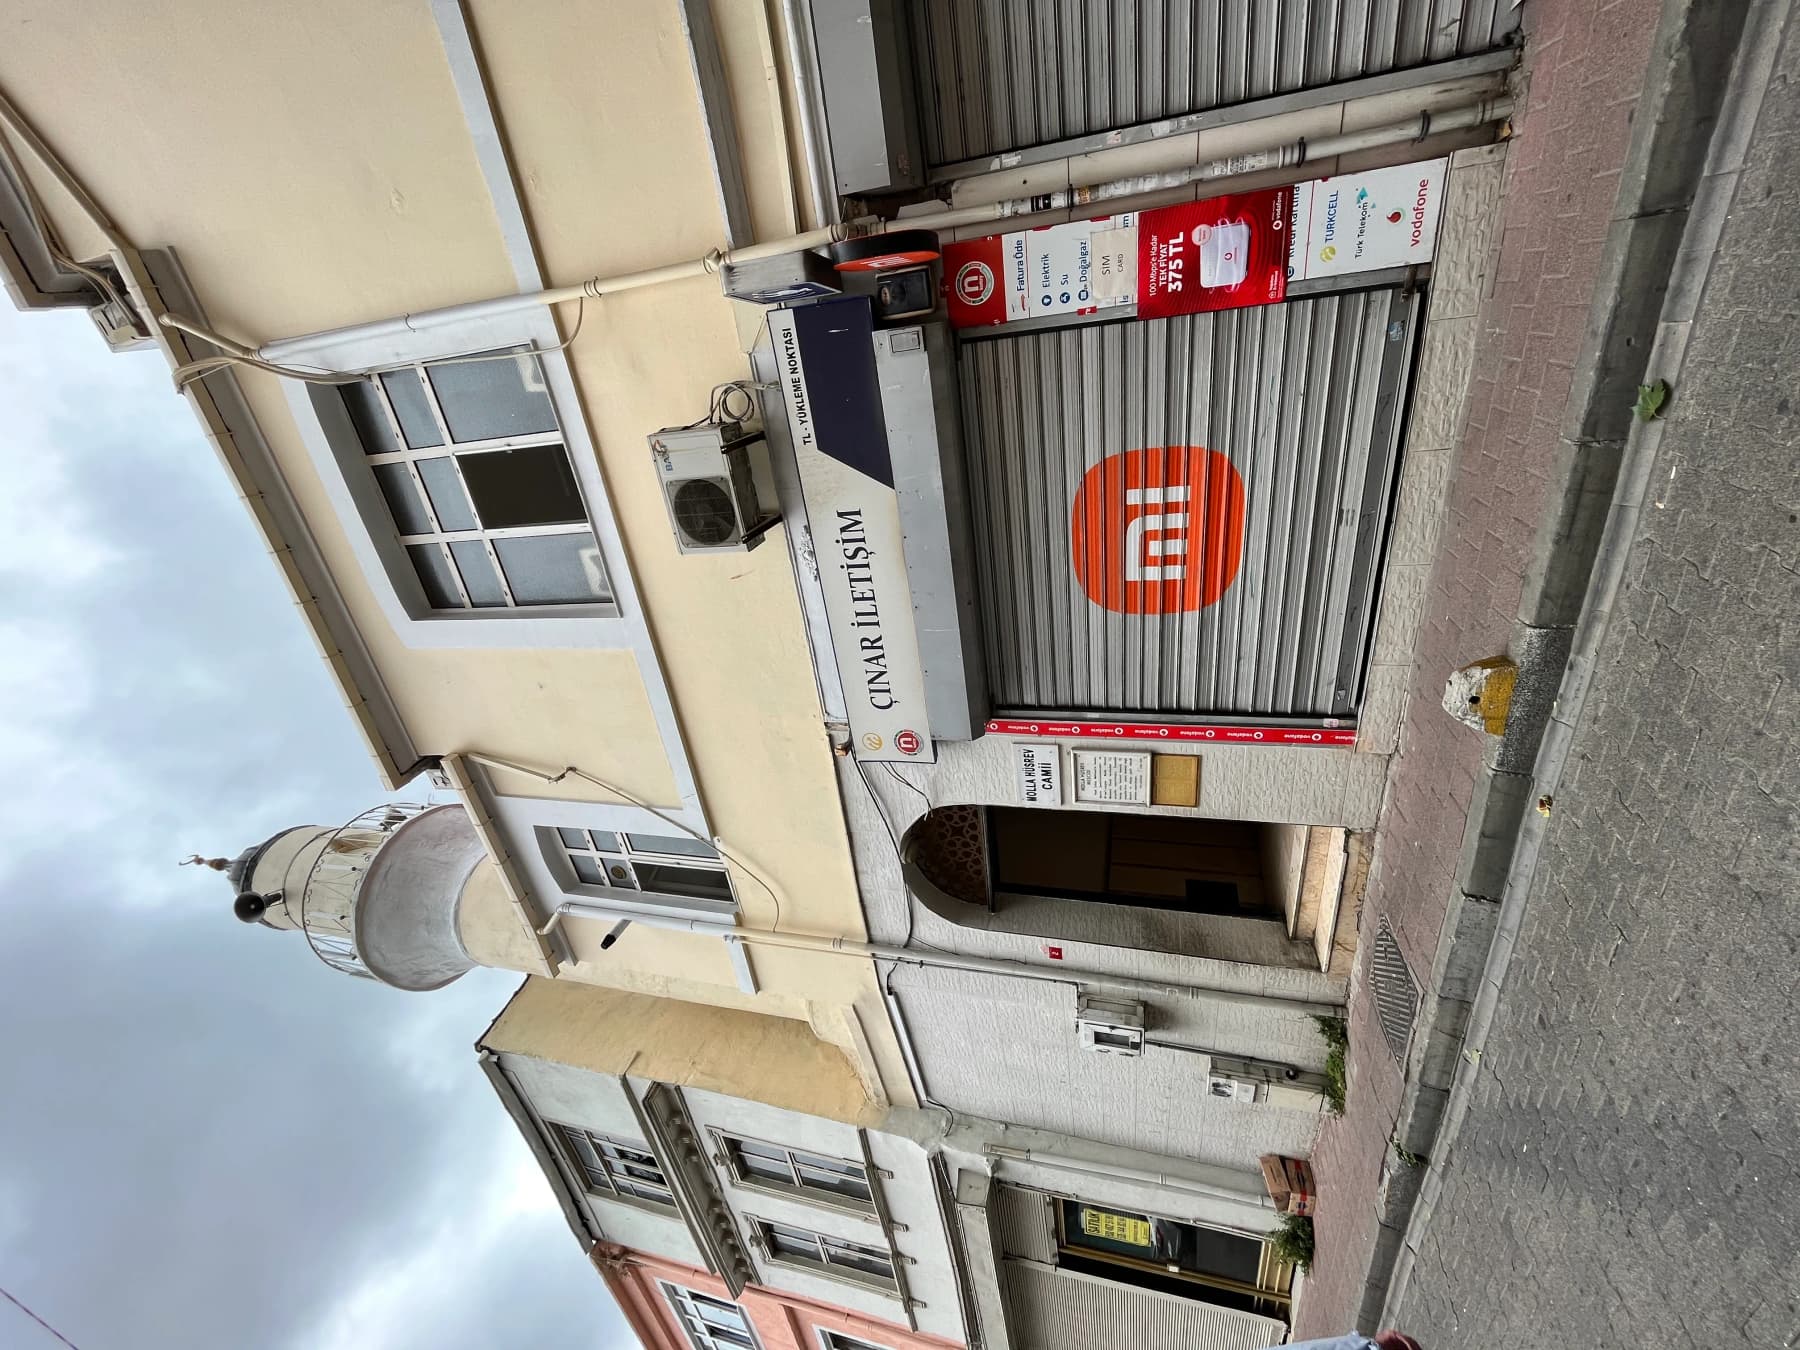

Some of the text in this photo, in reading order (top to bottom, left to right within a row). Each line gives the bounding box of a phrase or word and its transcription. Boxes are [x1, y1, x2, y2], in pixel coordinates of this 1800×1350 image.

[1275, 191, 1284, 219] vodafone
[1324, 190, 1339, 244] TURKCELL
[1410, 179, 1429, 247] vodafone
[1150, 234, 1158, 255] Kadar
[1354, 202, 1368, 259] Türk Telekom
[1012, 240, 1025, 291] Fatura Öde
[1041, 254, 1050, 288] Elektrik
[1060, 274, 1069, 285] Su
[1078, 240, 1089, 282] Doğalgaz
[1101, 254, 1111, 276] SIM
[1116, 253, 1124, 272] CARD
[1157, 243, 1168, 287] TEK FİYAT
[1167, 231, 1184, 293] 375 TL
[1149, 282, 1158, 296] 100
[782, 327, 800, 374] NOKTASI
[790, 377, 808, 425] YÜKLEME
[803, 433, 812, 446] TL
[835, 508, 900, 710] ÇINAR İLETİŞİM
[1022, 748, 1038, 802] MOLLA HÜSREV
[1038, 762, 1052, 790] CAMİİ
